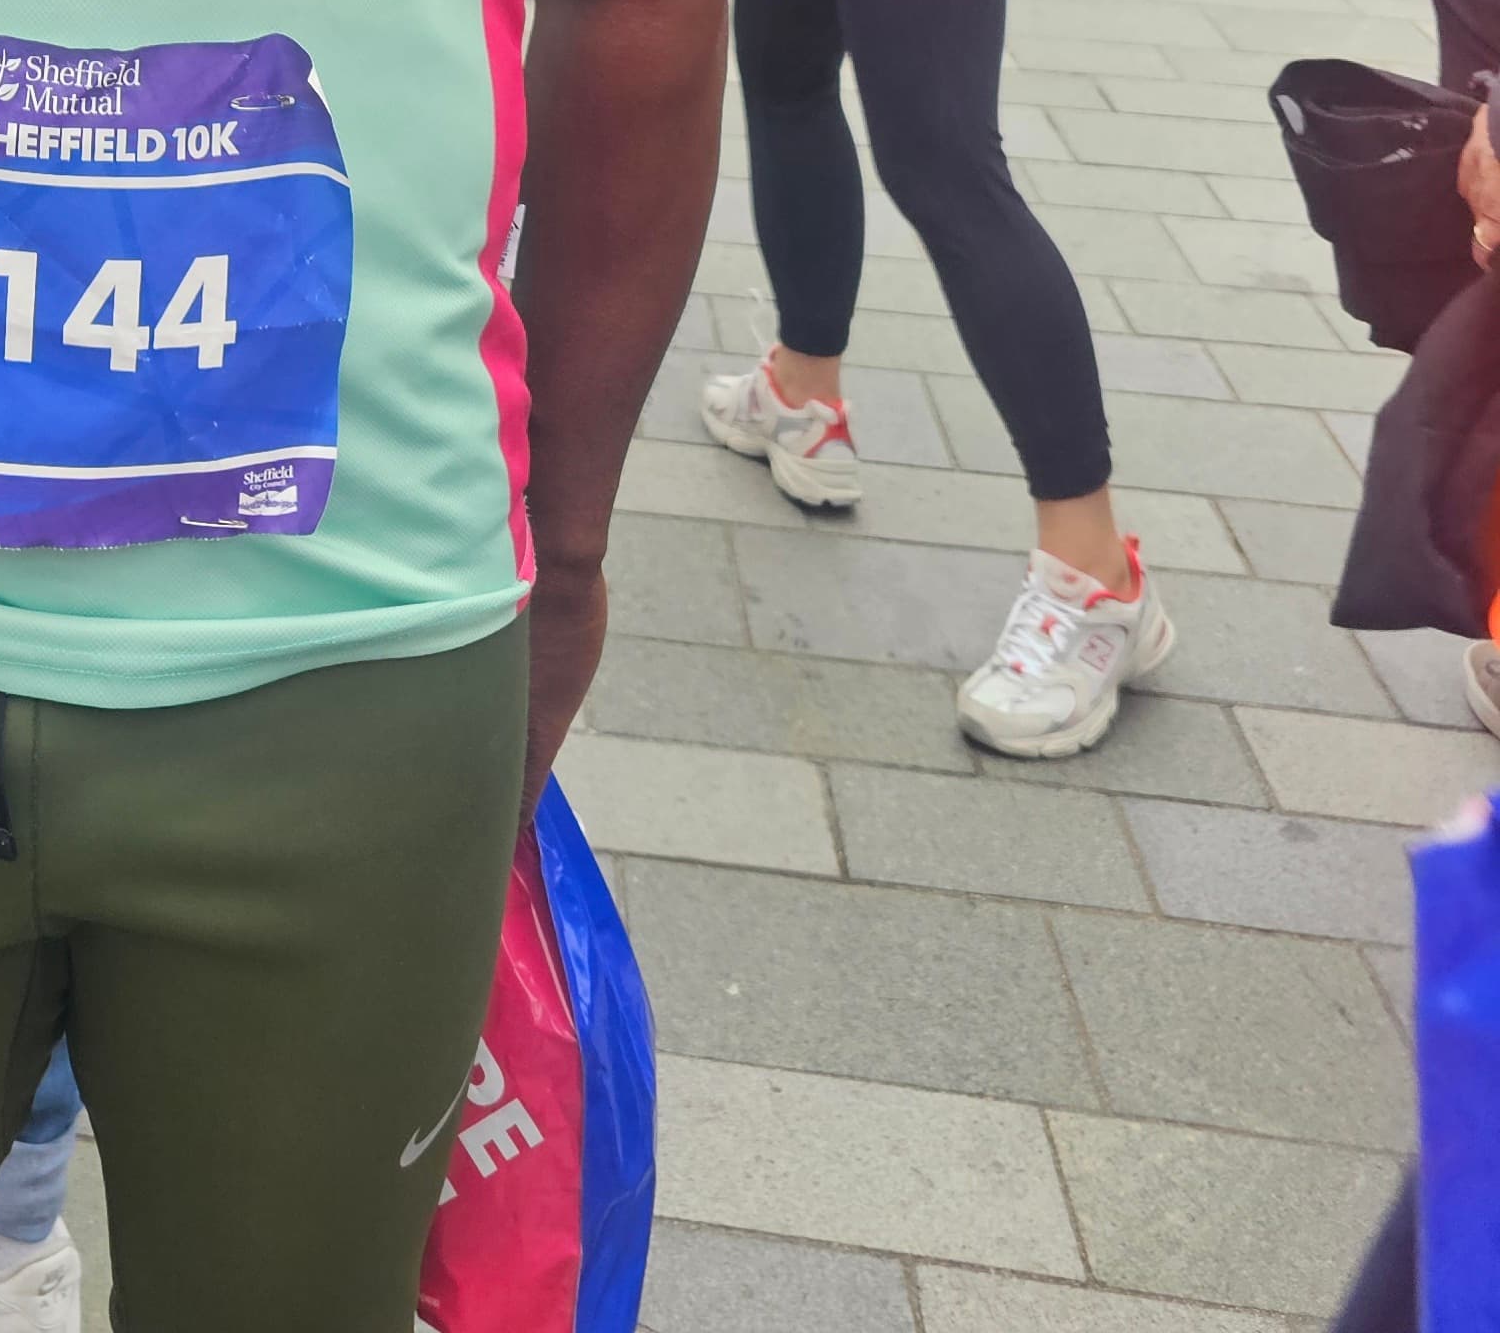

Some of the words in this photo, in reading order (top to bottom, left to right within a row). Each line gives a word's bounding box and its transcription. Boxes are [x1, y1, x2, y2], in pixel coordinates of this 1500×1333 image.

[25, 54, 141, 90] Sheffield
[22, 84, 123, 116] Mutual
[173, 120, 240, 161] 10K
[243, 464, 295, 486] Sheffield
